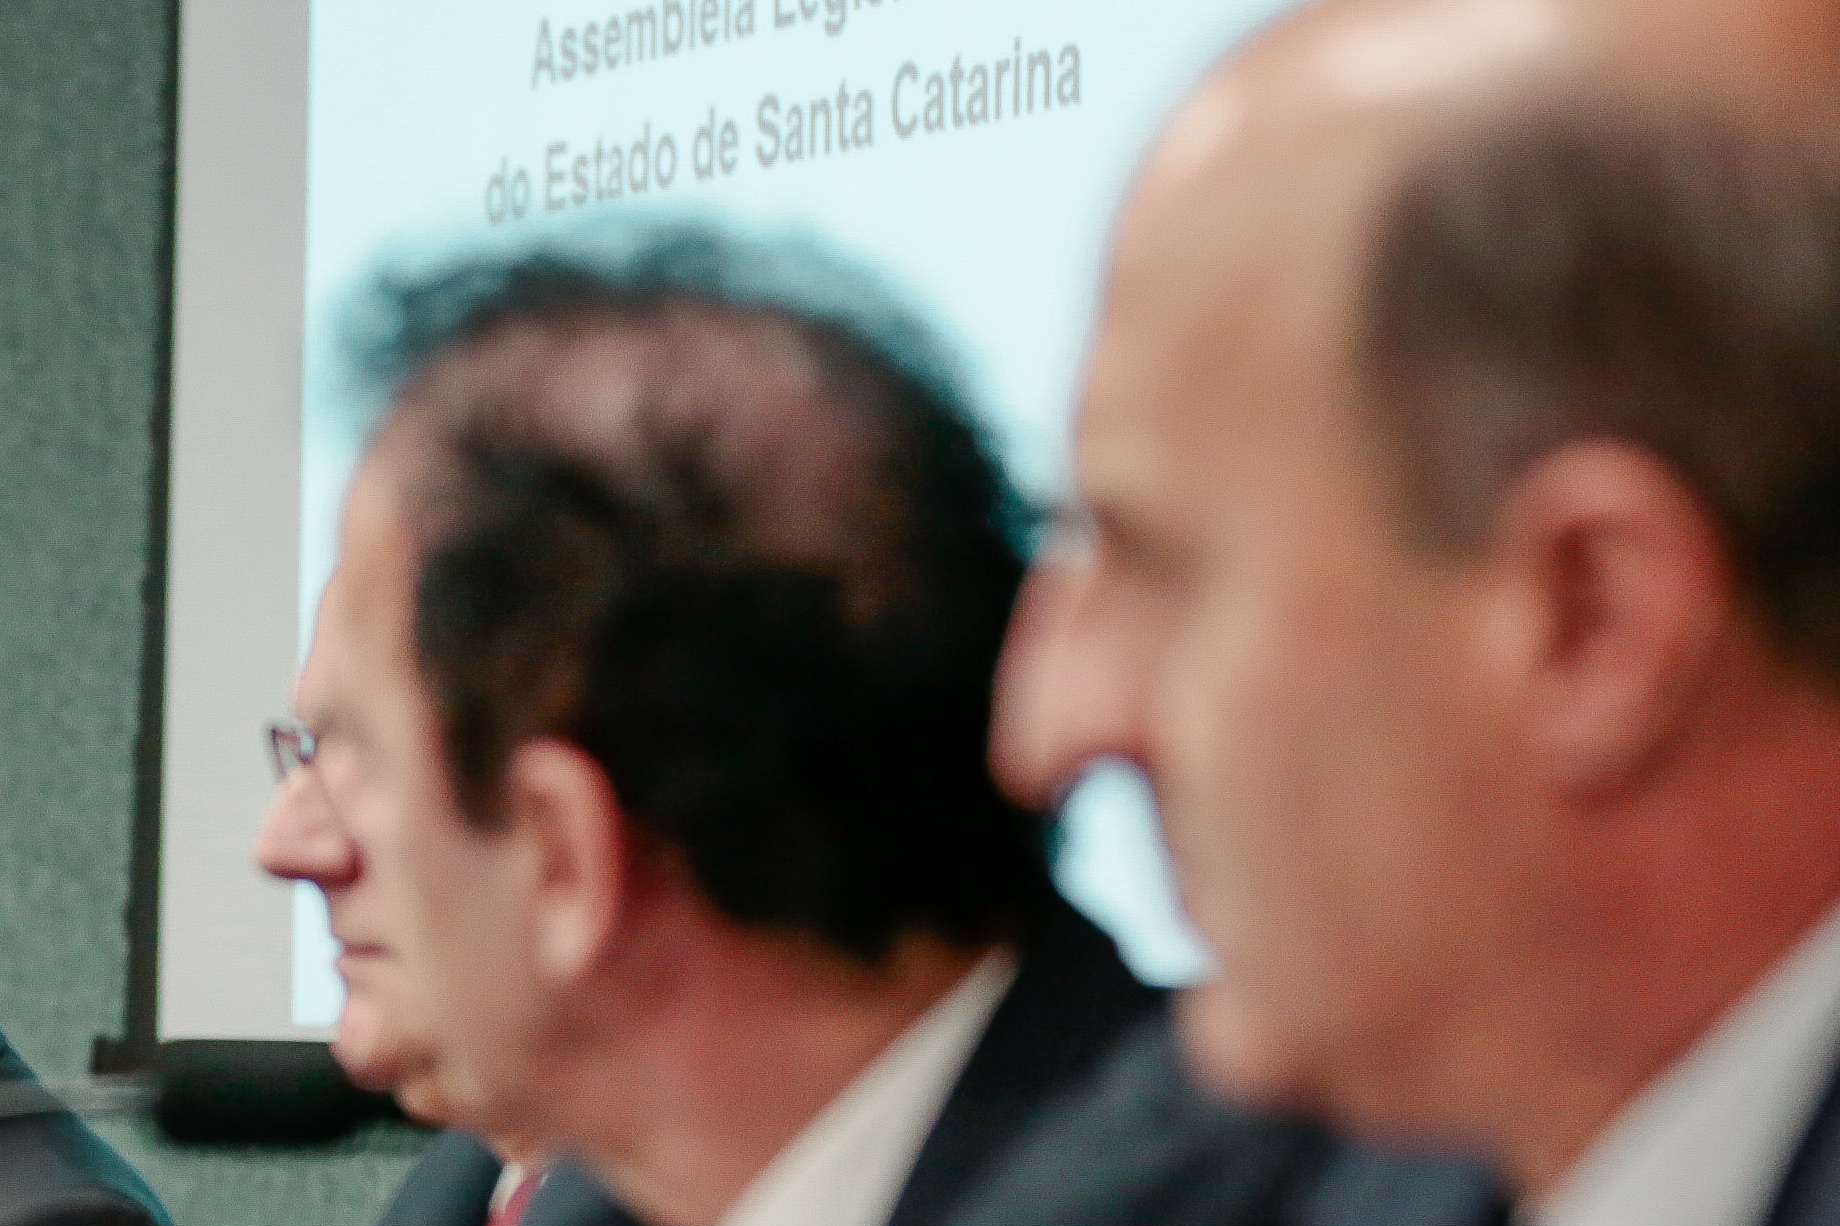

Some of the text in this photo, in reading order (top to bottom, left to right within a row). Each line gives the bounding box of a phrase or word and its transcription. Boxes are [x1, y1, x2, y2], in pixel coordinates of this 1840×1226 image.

[486, 37, 1082, 225] do Estado de Santa Catarina
